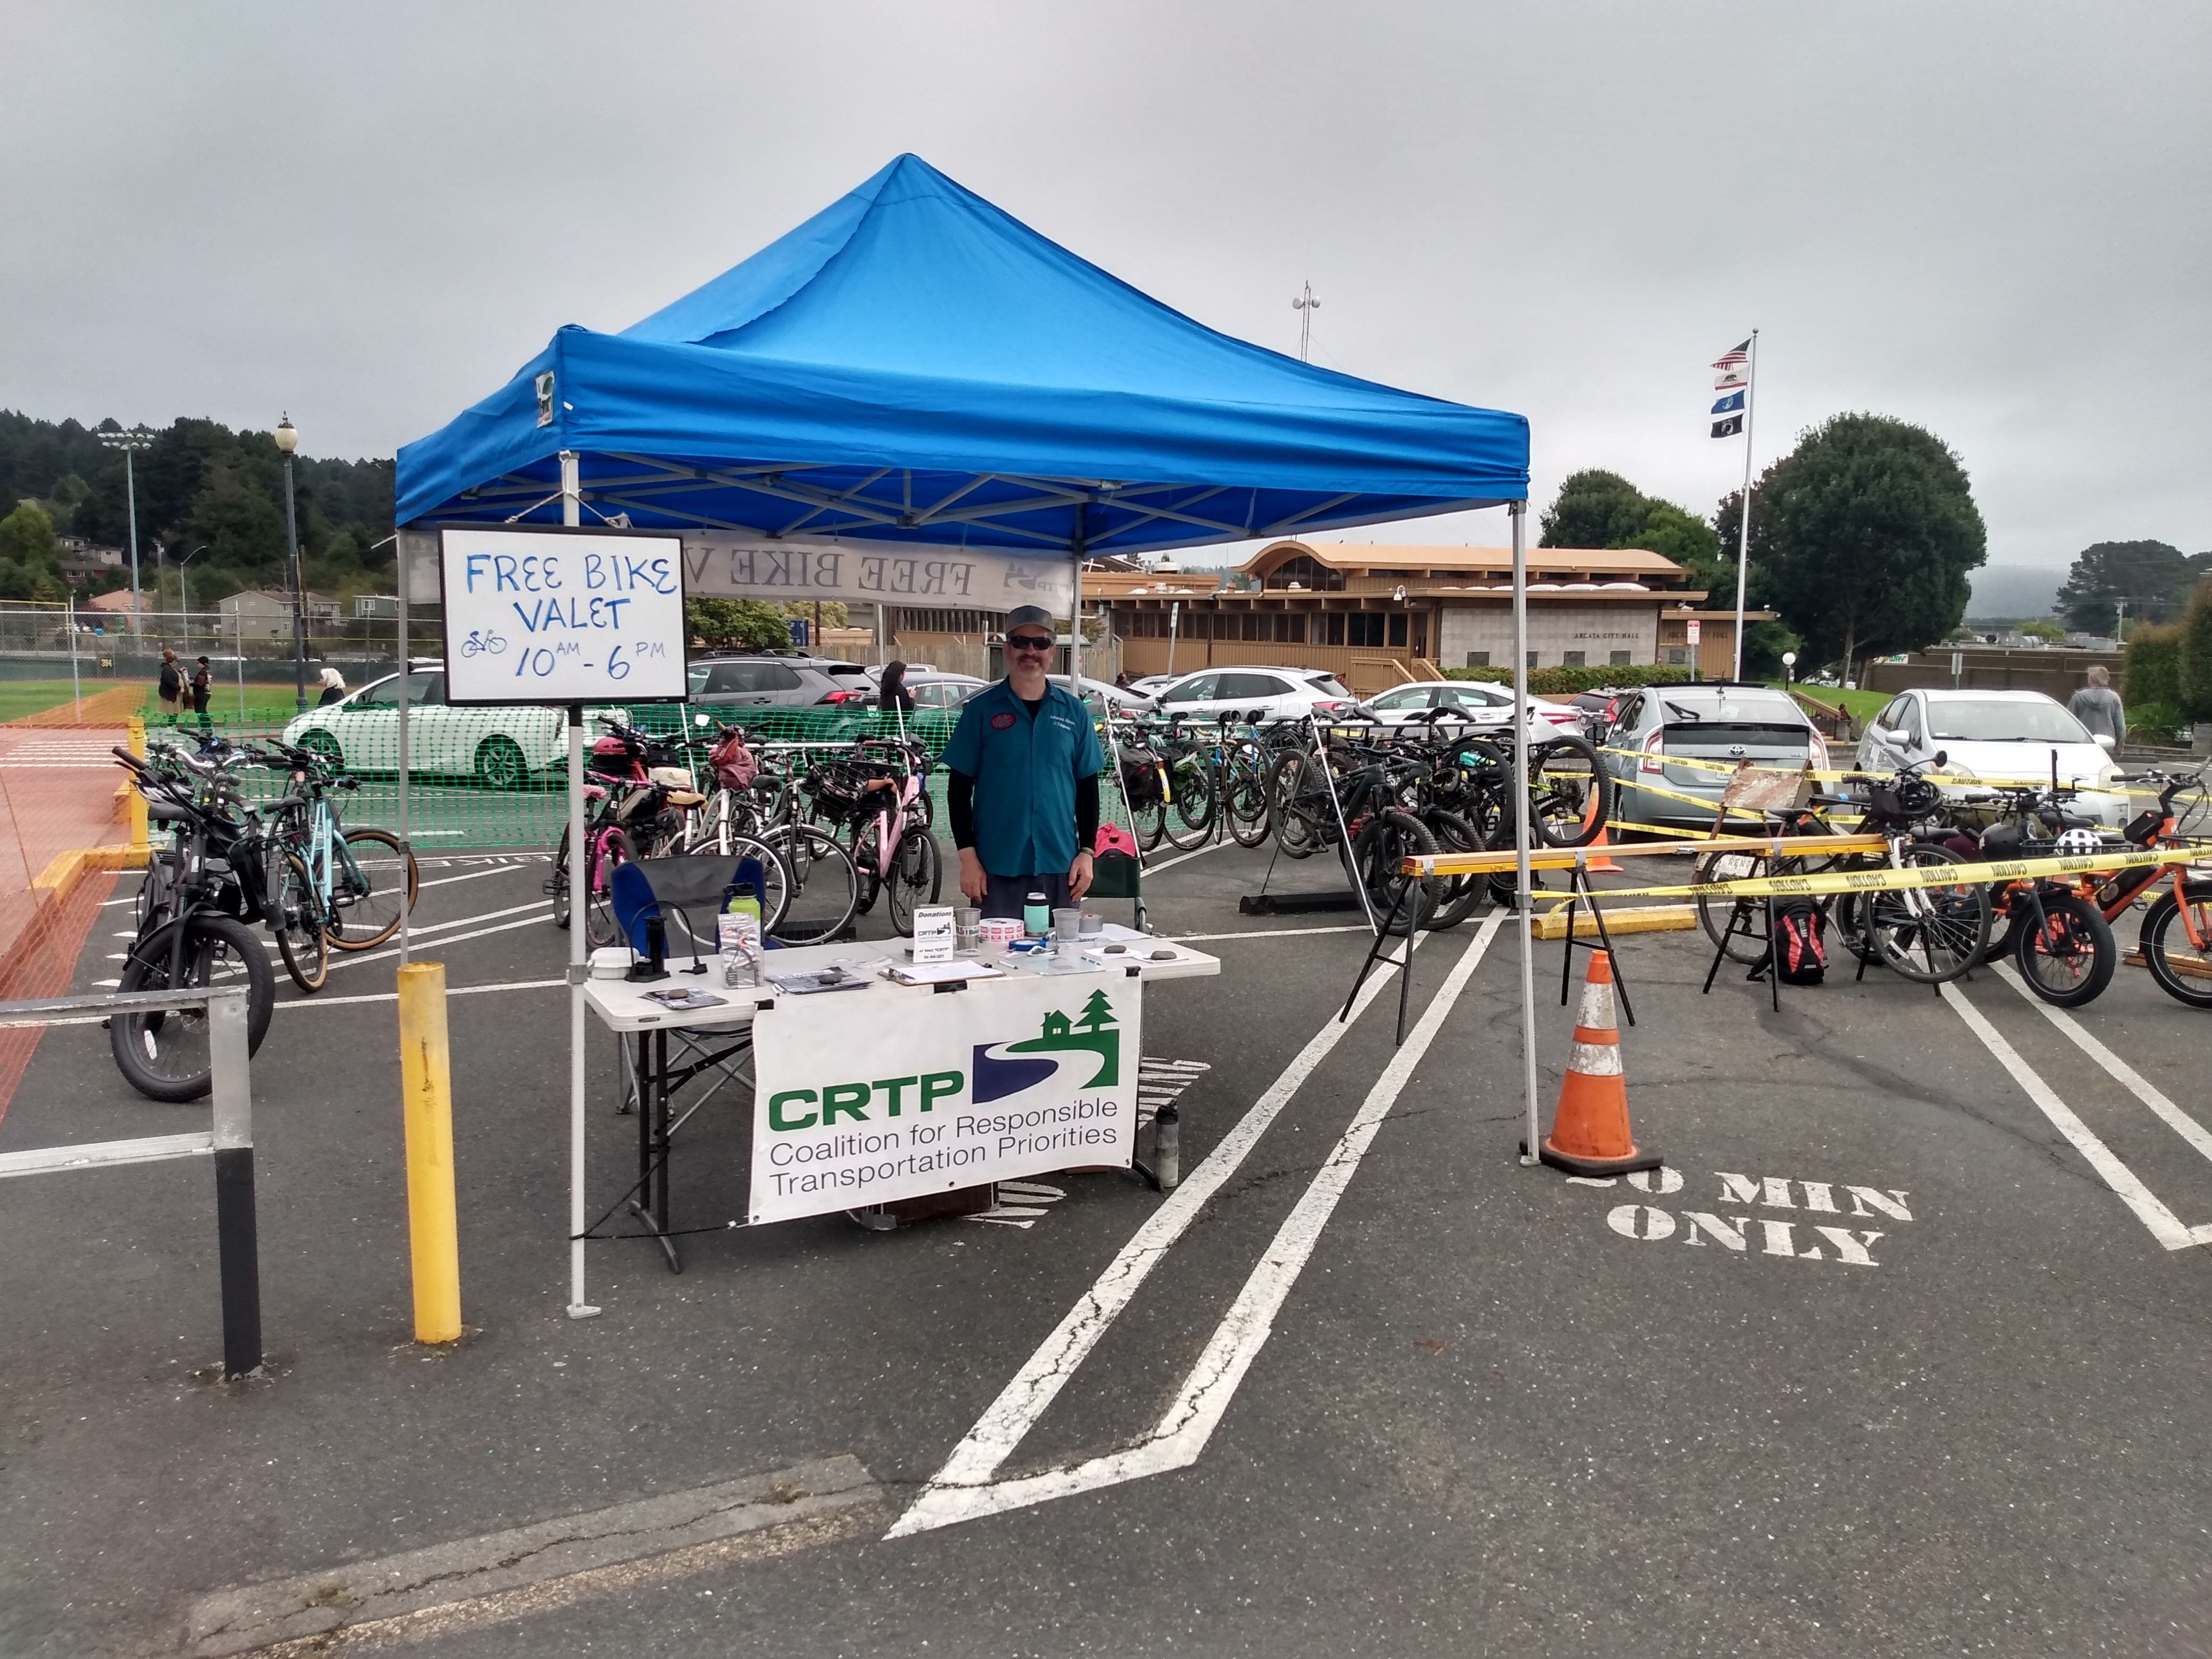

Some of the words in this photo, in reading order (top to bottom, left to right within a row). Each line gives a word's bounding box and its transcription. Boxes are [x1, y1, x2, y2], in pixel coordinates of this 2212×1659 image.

[467, 554, 562, 593] FREE
[585, 554, 677, 594] BIKE
[513, 597, 631, 633] VALET
[1728, 857, 1752, 868] RENT
[1769, 878, 1812, 892] CAUTION
[1845, 873, 1887, 888] CAUTION
[1920, 867, 1958, 883] CAUTION
[1990, 863, 2027, 877] CAUTION
[2060, 857, 2094, 870] CAUTION
[2123, 852, 2158, 865] CAUTION
[768, 1070, 965, 1133] CRTP
[770, 1130, 900, 1167] Coalition
[910, 1123, 946, 1144] for
[956, 1097, 1118, 1138] Responsible
[770, 1145, 987, 1196] Transportation
[998, 1126, 1118, 1159] Priorities
[1714, 1171, 1914, 1221] MIN
[1606, 1204, 1886, 1267] ONLY
